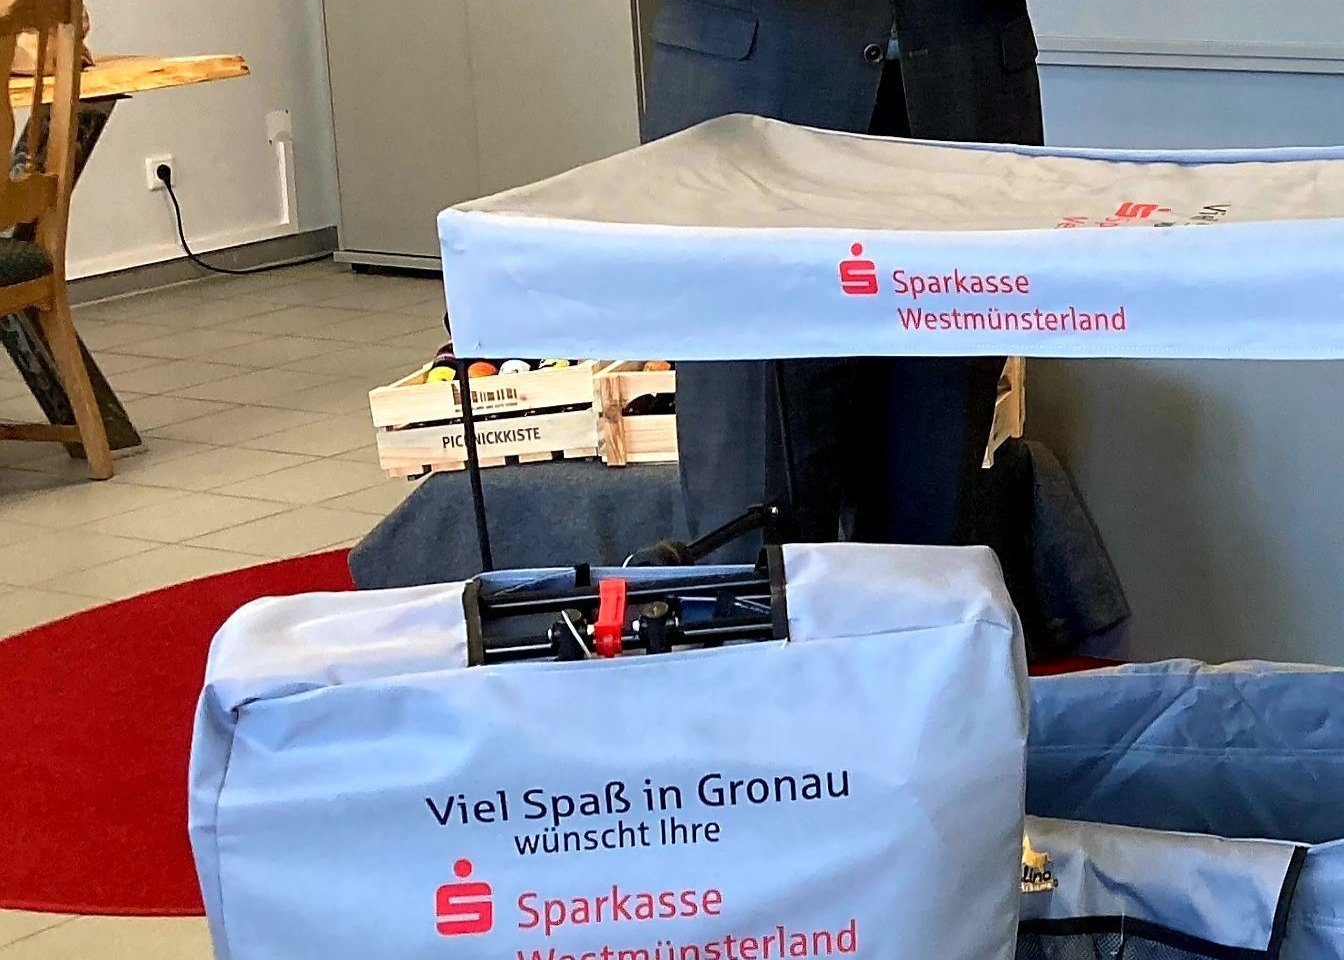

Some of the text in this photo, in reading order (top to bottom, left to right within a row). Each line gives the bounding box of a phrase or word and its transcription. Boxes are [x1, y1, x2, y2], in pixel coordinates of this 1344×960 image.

[892, 268, 1030, 300] Sparkasse
[897, 306, 1127, 331] Westmünsterland
[442, 427, 542, 449] PICNICKKISTE
[426, 769, 850, 827] Viel Spaß in Gronau
[514, 817, 721, 856] wünscht Ihre
[517, 884, 723, 937] Sparkasse
